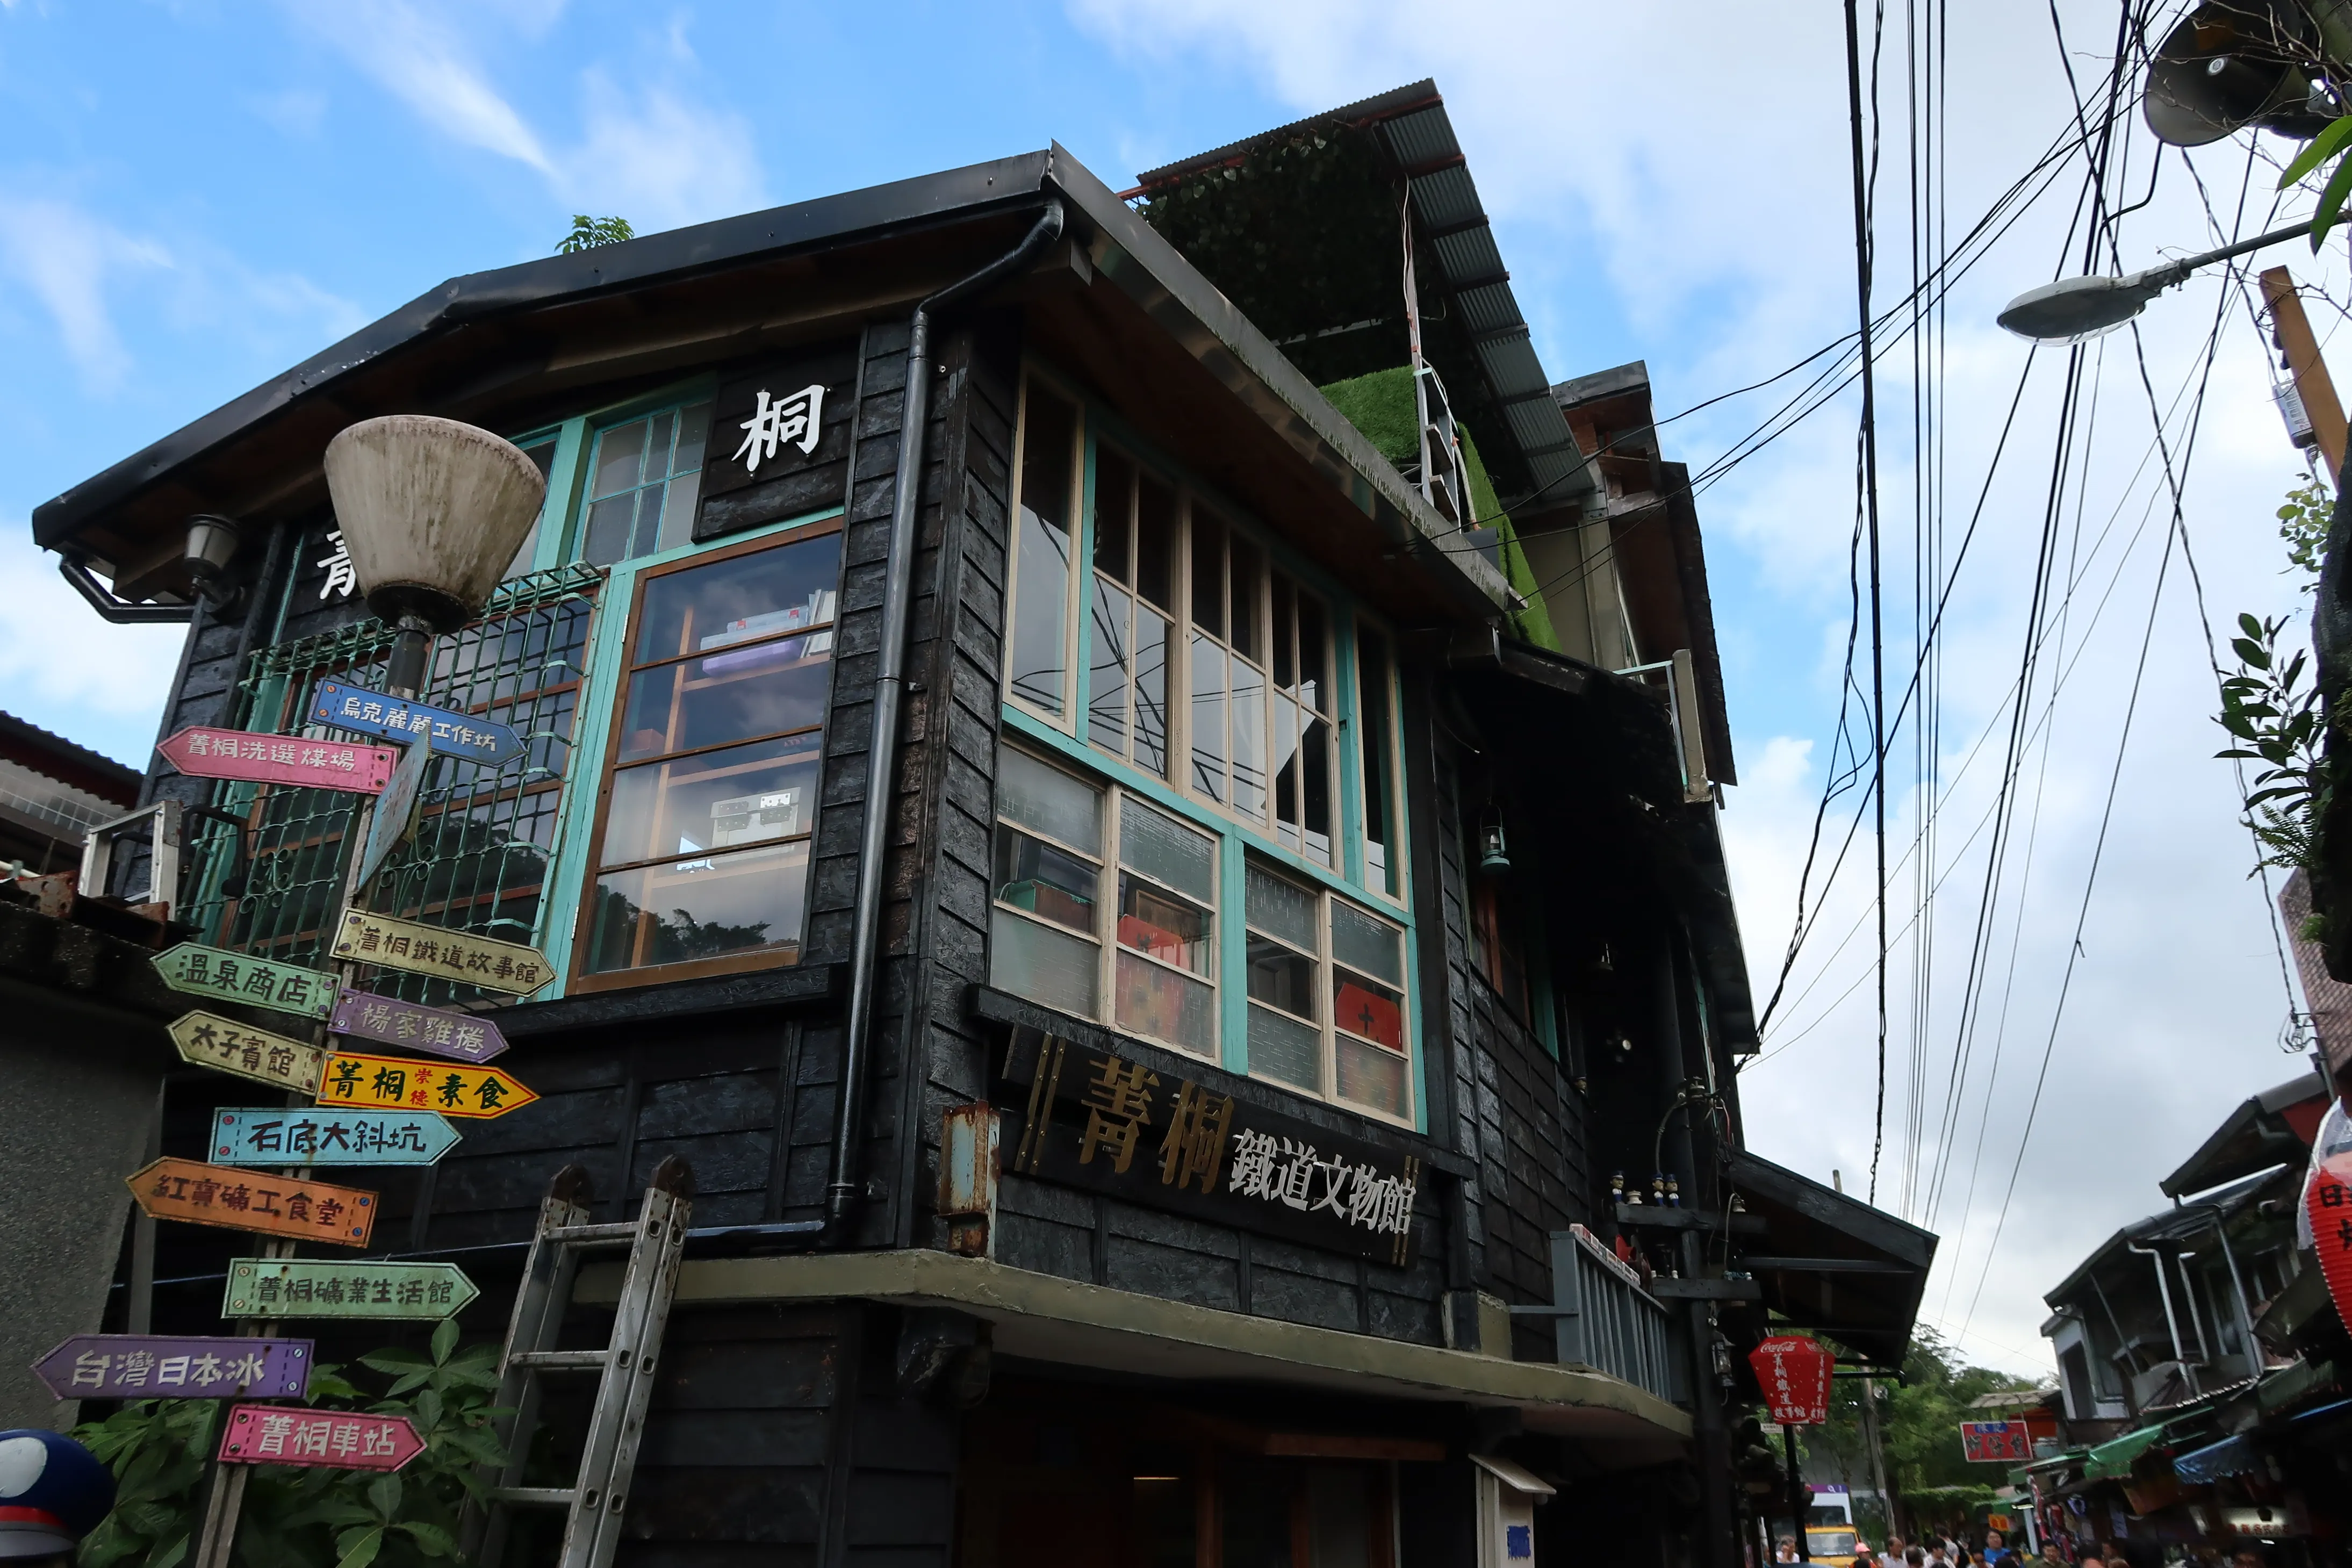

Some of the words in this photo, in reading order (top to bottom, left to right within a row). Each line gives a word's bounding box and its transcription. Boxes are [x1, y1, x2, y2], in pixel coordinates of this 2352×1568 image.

[731, 384, 825, 472] 桐
[187, 733, 356, 772] 菁桐洗選煤場
[175, 954, 312, 1005] 溫泉商店
[359, 926, 540, 983] 菁桐鐵道故事館
[190, 1024, 296, 1077] 太子賓館
[361, 1003, 485, 1054] 楊家雞捲
[248, 1119, 427, 1154] 石底大斜坑
[151, 1174, 344, 1226] 紅寶礦工食堂
[258, 1276, 454, 1304] 菁桐礦業生活館
[70, 1349, 265, 1388] 台灣日本冰
[257, 1414, 396, 1457] 菁桐車站
